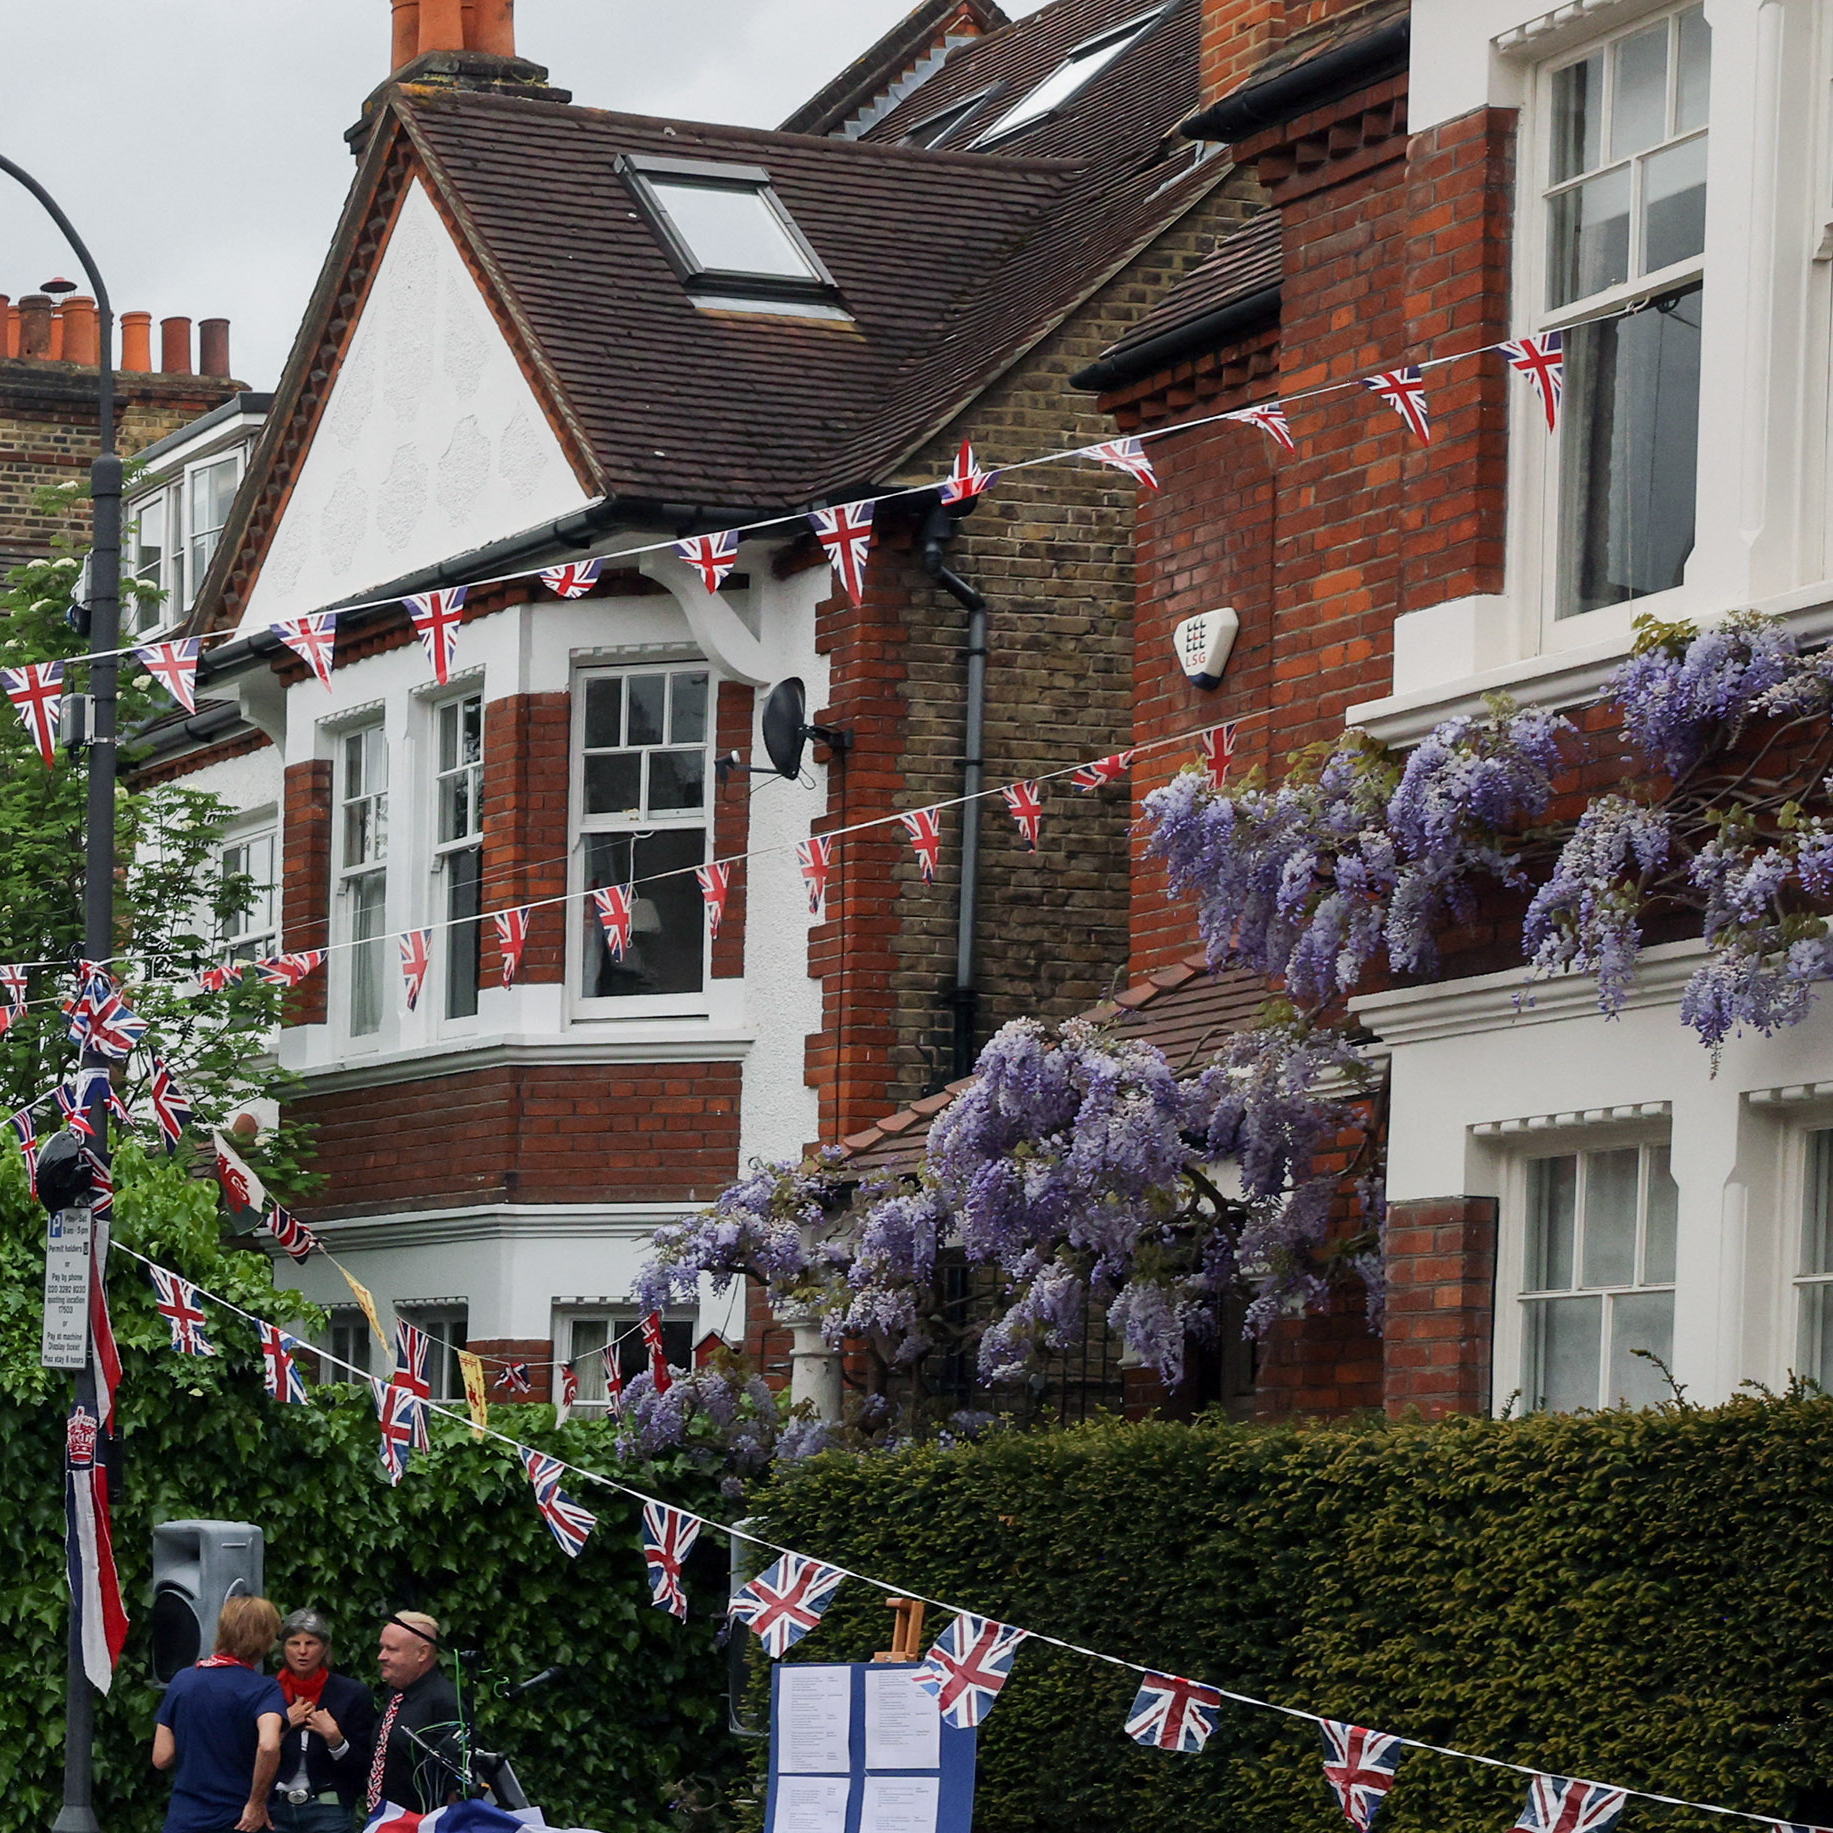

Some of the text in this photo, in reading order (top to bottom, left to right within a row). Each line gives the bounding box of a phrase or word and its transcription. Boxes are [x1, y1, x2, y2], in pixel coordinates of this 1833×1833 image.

[1185, 651, 1207, 668] LSG
[52, 1273, 60, 1282] Pay
[68, 1273, 83, 1282] phone
[47, 1332, 55, 1341] Pay
